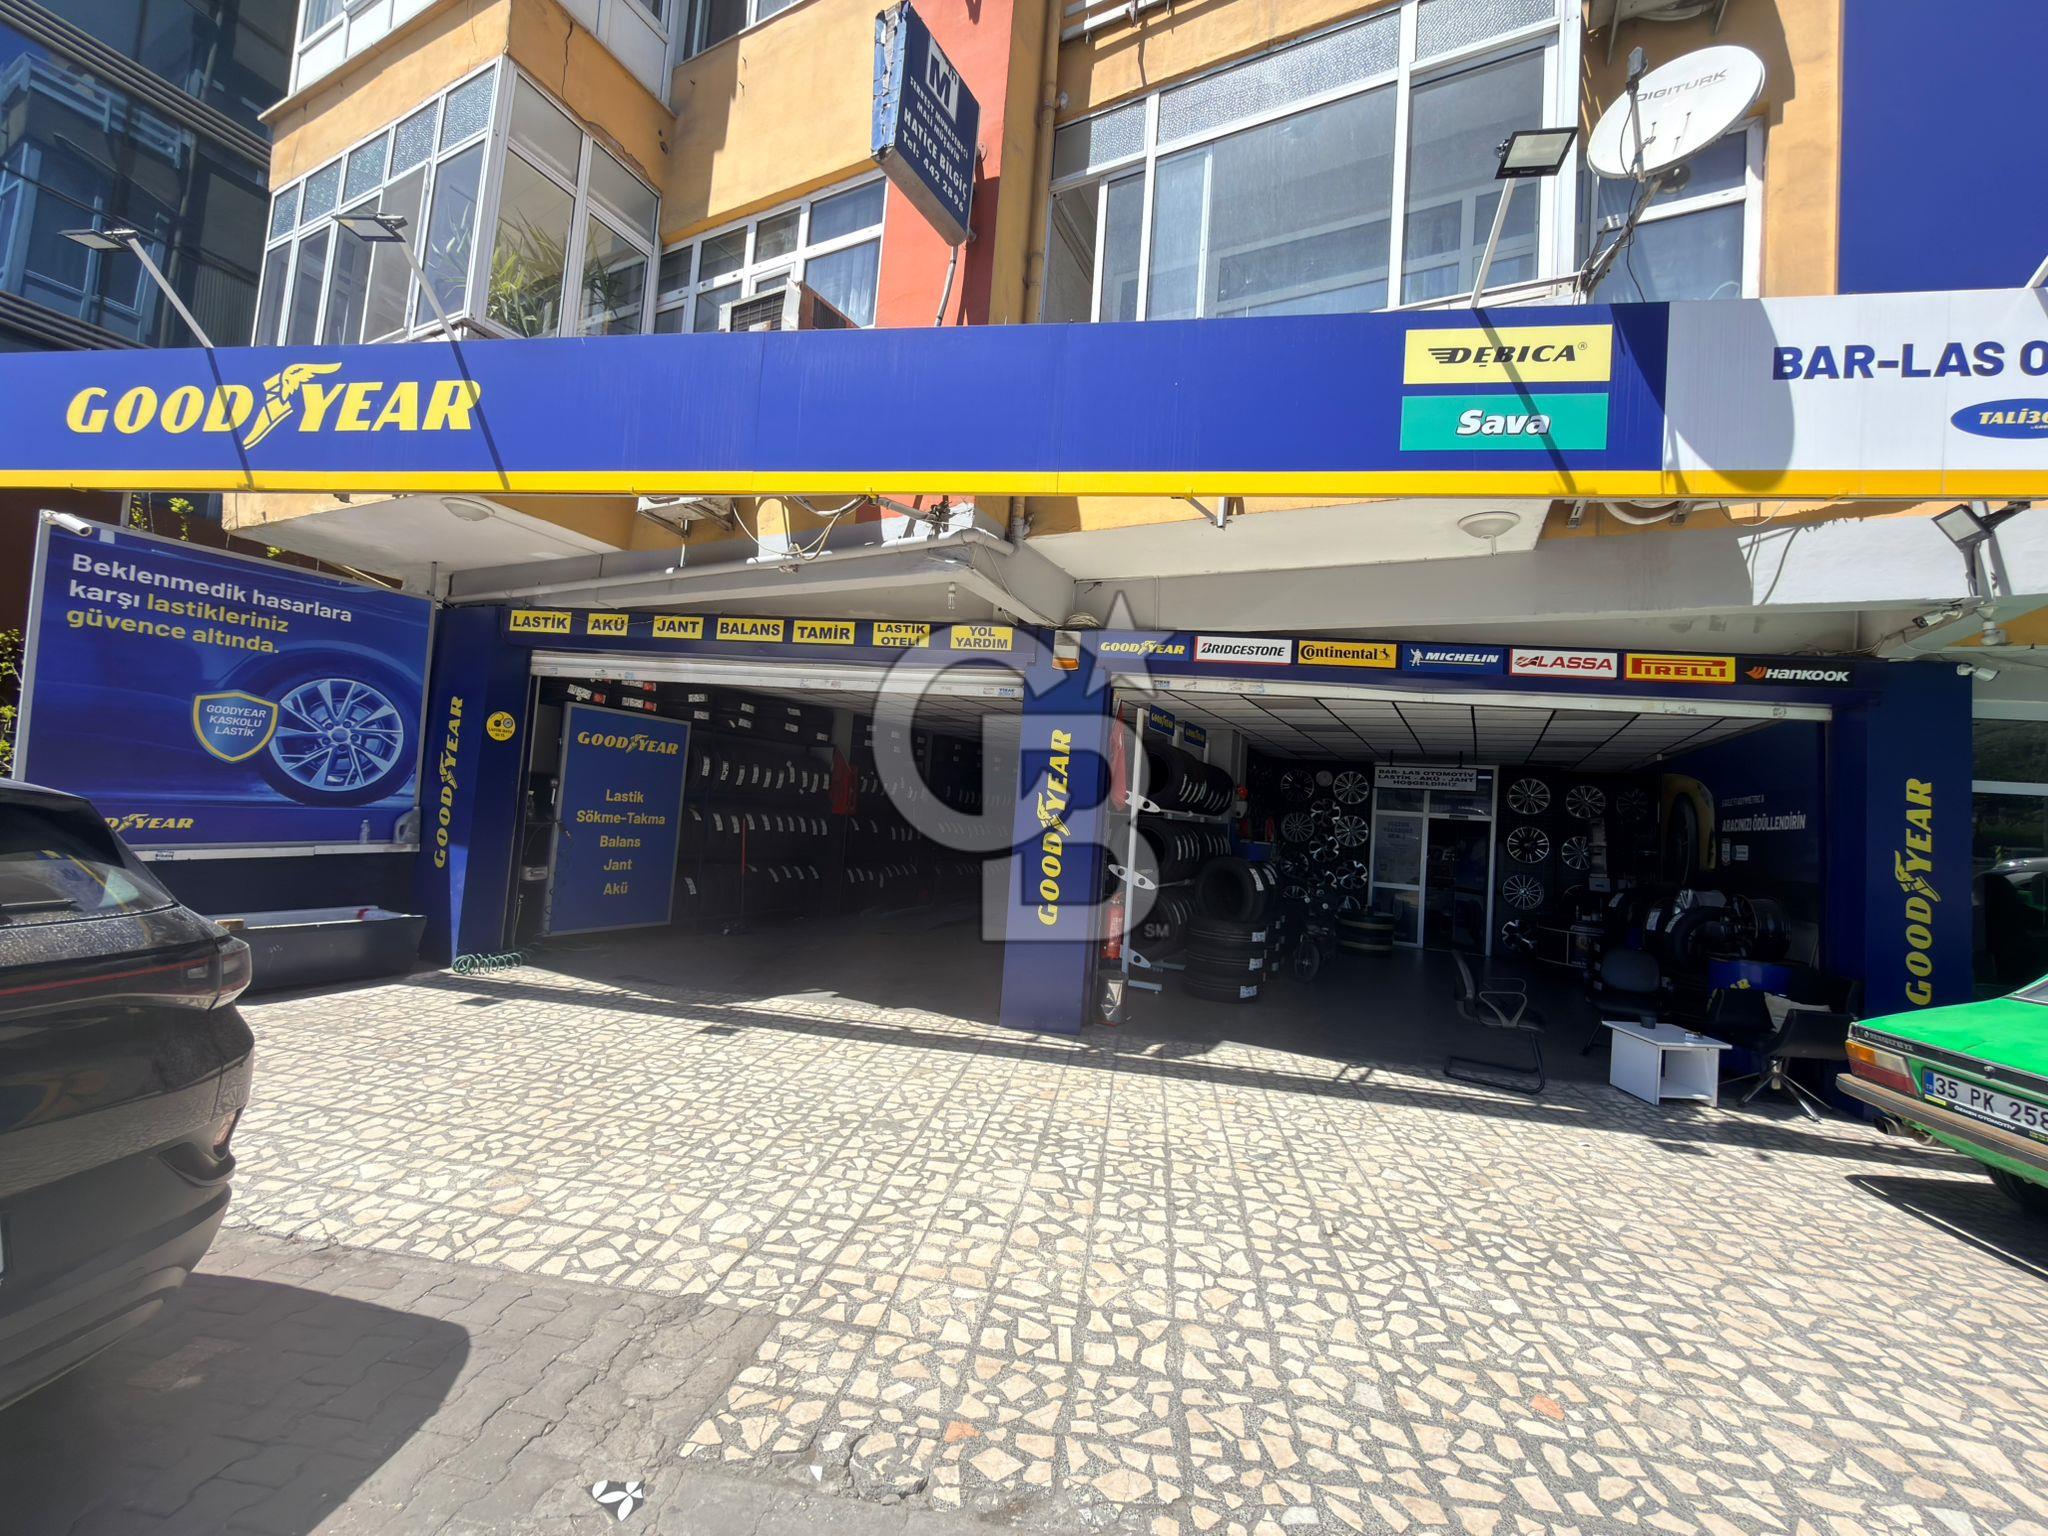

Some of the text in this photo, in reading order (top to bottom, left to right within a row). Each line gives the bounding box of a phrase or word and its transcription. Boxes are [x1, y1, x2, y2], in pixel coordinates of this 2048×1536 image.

[1635, 69, 1728, 101] DIGITURK
[910, 76, 934, 112] SERBEST
[917, 101, 933, 127] MALİ
[903, 129, 919, 158] Tel:
[923, 158, 939, 183] 442
[904, 108, 968, 201] HATİCE BİLGİÇ
[1772, 341, 2005, 381] BAR-LAS
[66, 374, 482, 440] GOODYEAR
[1456, 409, 1550, 436] Sava
[72, 553, 352, 623] Beklenmedik hasarlara
[69, 579, 289, 633] karşı lastikleriniz
[513, 614, 568, 630] LASTİK
[591, 616, 625, 631] AKÜ
[656, 619, 700, 633] JANT
[720, 622, 781, 637] BALANS
[876, 622, 926, 634] LASTİK
[66, 608, 280, 654] güvence altında.
[798, 623, 850, 640] TAMİR
[969, 625, 996, 637] YOL
[881, 635, 921, 647] OTELİ
[955, 636, 1008, 649] YARDIM
[1100, 641, 1185, 657] GOODYEAR
[1200, 641, 1286, 657] BRIDGESTONE
[1300, 644, 1379, 661] Continental
[1425, 650, 1500, 666] MICHELIN
[1537, 655, 1614, 671] LASSA
[1631, 657, 1728, 678] PIRELLI
[206, 704, 267, 718] GOODYEAR
[209, 715, 262, 728] KASKOLU
[214, 726, 255, 737] LASTİK
[577, 732, 679, 755] GOODYEAR
[434, 696, 463, 869] GOODYEAR
[605, 789, 644, 803] Lastik
[576, 810, 666, 825] Sökme-Takma
[1038, 729, 1072, 926] GOODYEAR
[600, 835, 641, 848] Balans
[603, 859, 632, 871] Jant
[603, 883, 628, 895] Akü
[1902, 778, 1936, 1006] GOODYEAR
[1935, 1077, 1958, 1100] 35
[1970, 1088, 1995, 1114] PK
